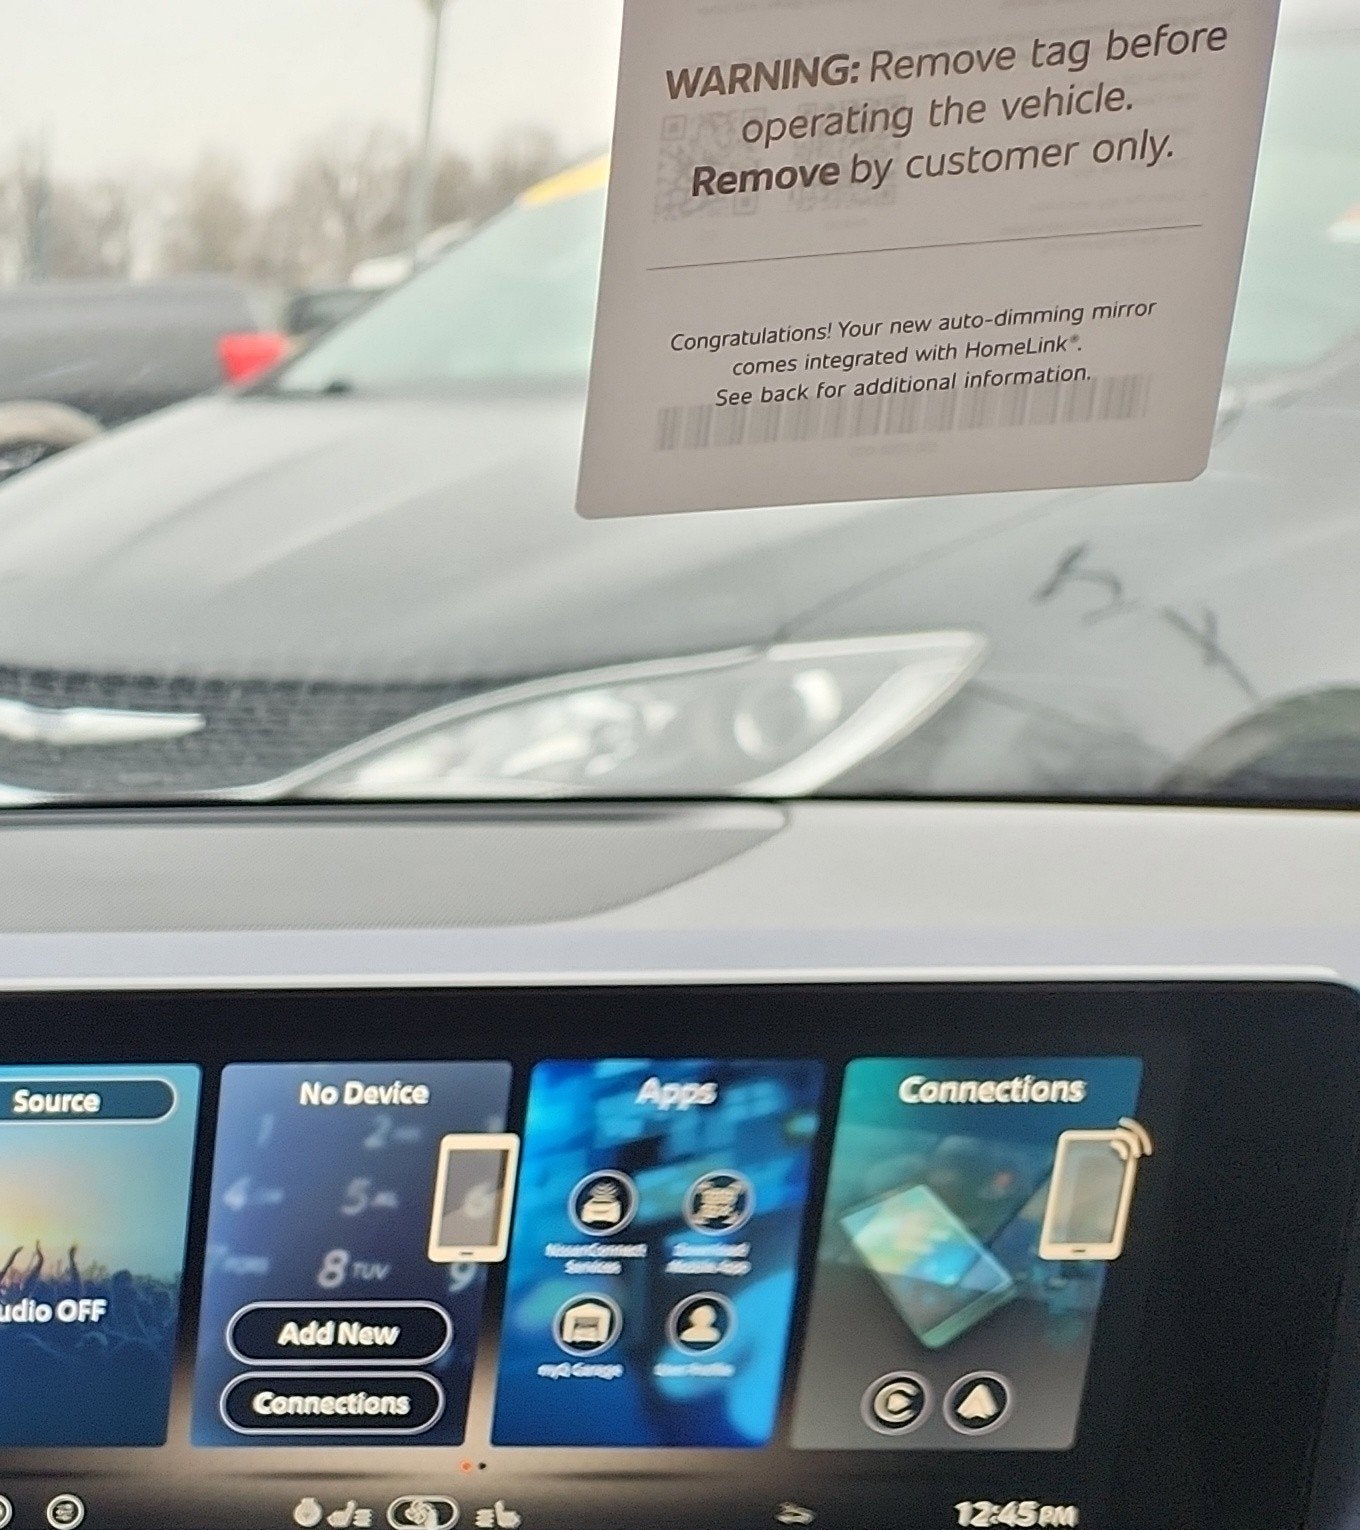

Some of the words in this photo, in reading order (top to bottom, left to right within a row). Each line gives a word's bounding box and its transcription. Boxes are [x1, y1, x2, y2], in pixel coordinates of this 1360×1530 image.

[666, 53, 861, 100] WARNING:
[870, 46, 1017, 82] Remove
[1031, 38, 1091, 72] tag
[1106, 23, 1228, 61] before
[741, 102, 914, 149] operating
[929, 95, 987, 127] the
[1002, 81, 1133, 121] vehicle.
[692, 160, 841, 196] Remove
[850, 152, 894, 190] by
[906, 141, 1080, 179] customer
[1093, 128, 1174, 167] only.
[670, 321, 832, 352] Congratulations!
[838, 321, 884, 339] Your
[890, 317, 933, 335] new
[938, 305, 1084, 331] auto-dimming
[1092, 301, 1157, 320] mirror
[733, 357, 798, 376] comes
[805, 347, 909, 372] integrated
[915, 343, 957, 362] with
[716, 388, 752, 407] See
[760, 383, 810, 403] back
[816, 381, 847, 399] for
[853, 372, 957, 397] additional
[964, 365, 1092, 389] information.
[12, 1089, 101, 1115] Source
[299, 1081, 339, 1106] No
[343, 1081, 430, 1106] Device
[636, 1077, 718, 1109] Apps
[899, 1076, 1086, 1104] Connections
[317, 1249, 349, 1289] 8
[352, 1262, 391, 1281] TUV
[58, 1299, 107, 1323] OFF
[278, 1321, 333, 1347] Add
[336, 1322, 400, 1346] New
[253, 1391, 410, 1418] Connections
